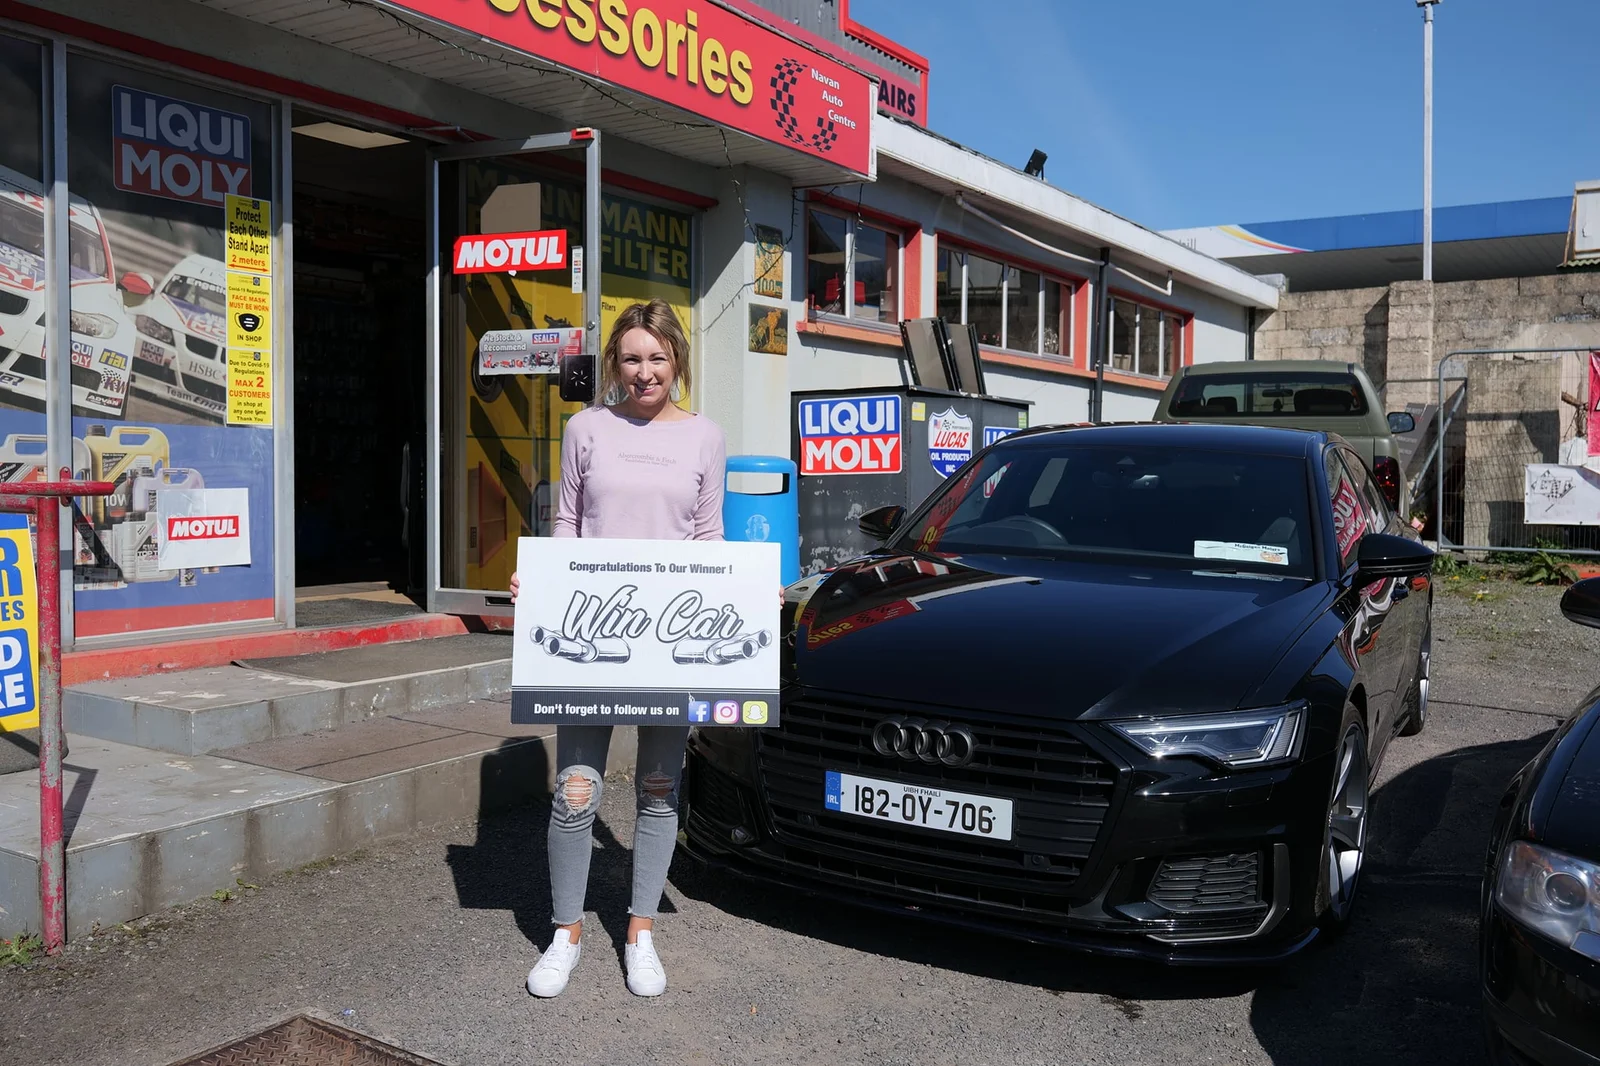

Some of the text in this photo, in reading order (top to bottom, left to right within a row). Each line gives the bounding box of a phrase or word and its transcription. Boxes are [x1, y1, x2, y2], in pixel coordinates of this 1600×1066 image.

[488, 0, 753, 104] essories
[811, 68, 840, 90] Navan
[822, 90, 843, 107] Auto
[879, 79, 916, 117] AIRS
[121, 92, 244, 159] LIQUI
[828, 109, 856, 130] Centre
[121, 143, 248, 201] MOLY
[235, 207, 261, 223] Protect
[600, 200, 688, 247] MANN
[230, 221, 267, 239] Each Other
[228, 237, 269, 256] Stand Apart
[456, 236, 563, 269] MOTUL
[232, 254, 266, 267] 2 meters
[229, 301, 244, 309] MUST
[253, 304, 269, 312] WORN
[248, 296, 266, 304] MASK
[601, 301, 616, 312] Filters
[483, 343, 527, 352] Recommend
[533, 334, 559, 344] SEALEY
[71, 341, 93, 356] QUI
[71, 353, 92, 367] OLY
[229, 359, 239, 367] Due
[188, 361, 221, 380] HSBC
[234, 368, 265, 376] Regulations
[235, 376, 264, 388] MAX 2
[166, 385, 192, 402] Team
[228, 390, 270, 399] CUSTOMERS
[243, 401, 256, 409] shop
[804, 400, 895, 436] LIQUI
[933, 431, 969, 448] LUCAS
[805, 437, 899, 471] MOLY
[931, 452, 970, 461] OIL PRODUCTS
[171, 518, 237, 538] MOTUL
[569, 561, 652, 574] Congratulations
[655, 562, 666, 574] To
[669, 562, 688, 574] Our
[690, 563, 727, 575] Winner
[562, 584, 744, 643] Win Car
[533, 703, 680, 718] Don't forget to follow us on
[827, 794, 839, 805] IRL
[855, 784, 993, 834] 182-OY-706
